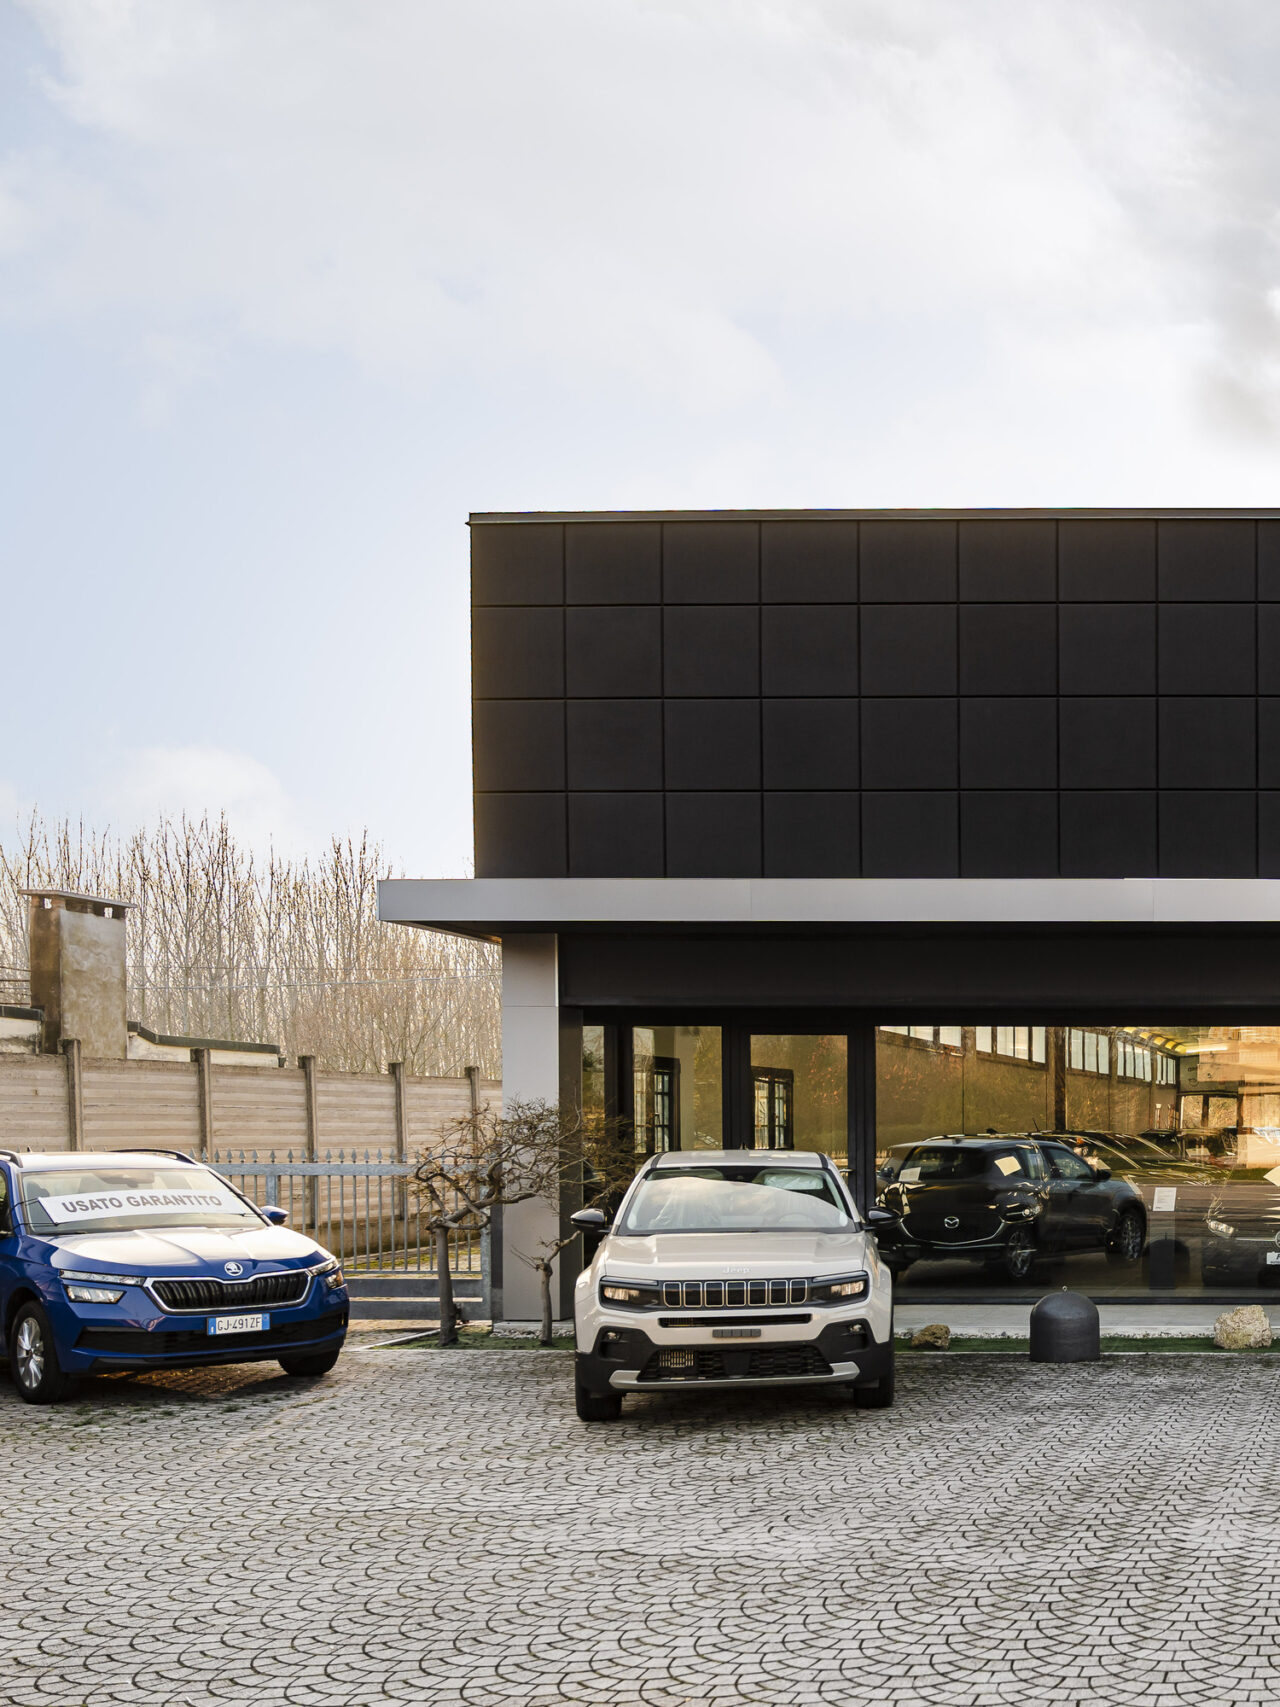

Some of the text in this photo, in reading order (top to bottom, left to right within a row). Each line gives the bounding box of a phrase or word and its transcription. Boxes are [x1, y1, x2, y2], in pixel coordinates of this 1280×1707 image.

[61, 1195, 223, 1213] USATO GARANTITO
[722, 1265, 752, 1274] Jeep
